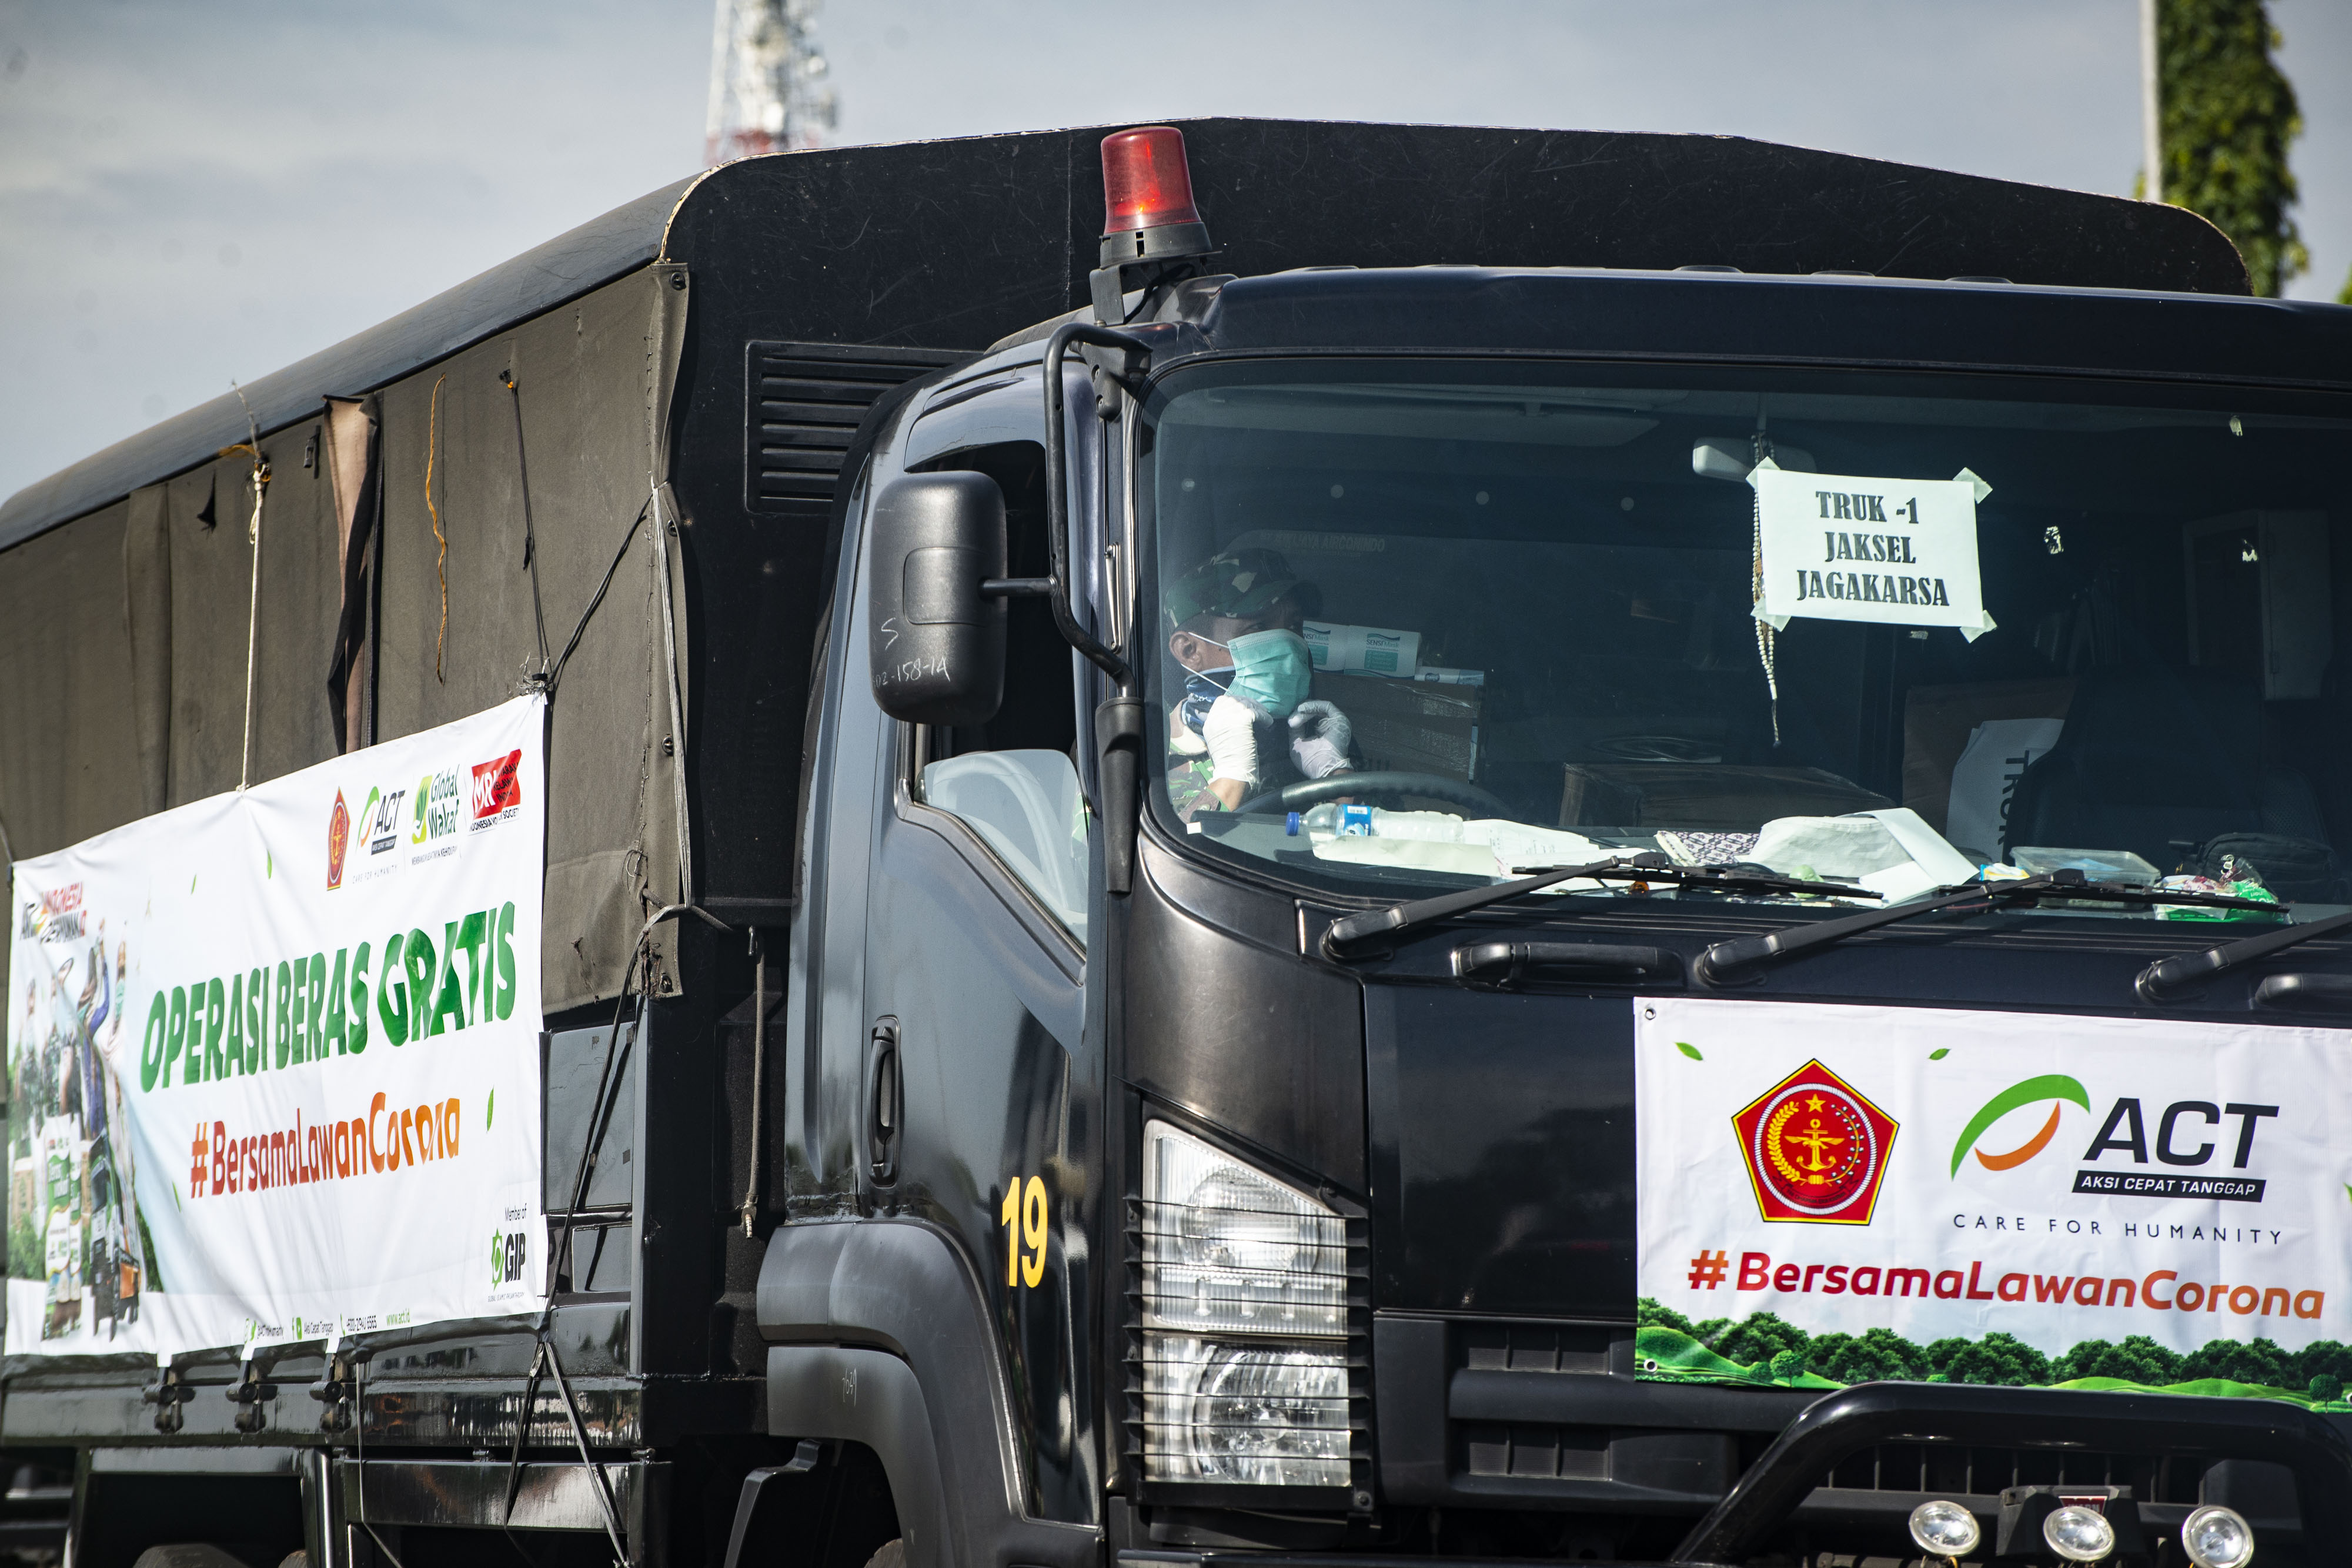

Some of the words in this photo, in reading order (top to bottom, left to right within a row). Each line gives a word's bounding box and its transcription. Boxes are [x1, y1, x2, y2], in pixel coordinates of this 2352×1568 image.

[1816, 491, 1887, 522] TRUK
[1896, 497, 1919, 524] -1
[1825, 531, 1916, 564] JAKSEL
[1797, 570, 1950, 606] JAGAKARSA
[431, 764, 460, 803] Global
[374, 790, 405, 835] ACT
[428, 799, 459, 840] Wakaf
[141, 967, 269, 1093] OPERASI
[275, 942, 371, 1070] BERAS
[377, 901, 516, 1047] GRATIS
[191, 1092, 460, 1199] #BersamaLawanCorona
[2082, 1098, 2280, 1168] ACT
[2081, 1176, 2119, 1189] AKSI
[2124, 1178, 2176, 1192] CEPAT
[2181, 1181, 2256, 1196] TANGGAP
[505, 1205, 521, 1222] Member
[522, 1203, 527, 1219] of
[1002, 1176, 1048, 1288] 19
[1954, 1214, 2025, 1231] CARE
[2049, 1219, 2102, 1235] FOR
[2125, 1222, 2281, 1245] HUMANITY
[505, 1233, 526, 1283] GIP
[367, 1315, 377, 1329] 6565
[386, 1308, 410, 1326] www.act.id
